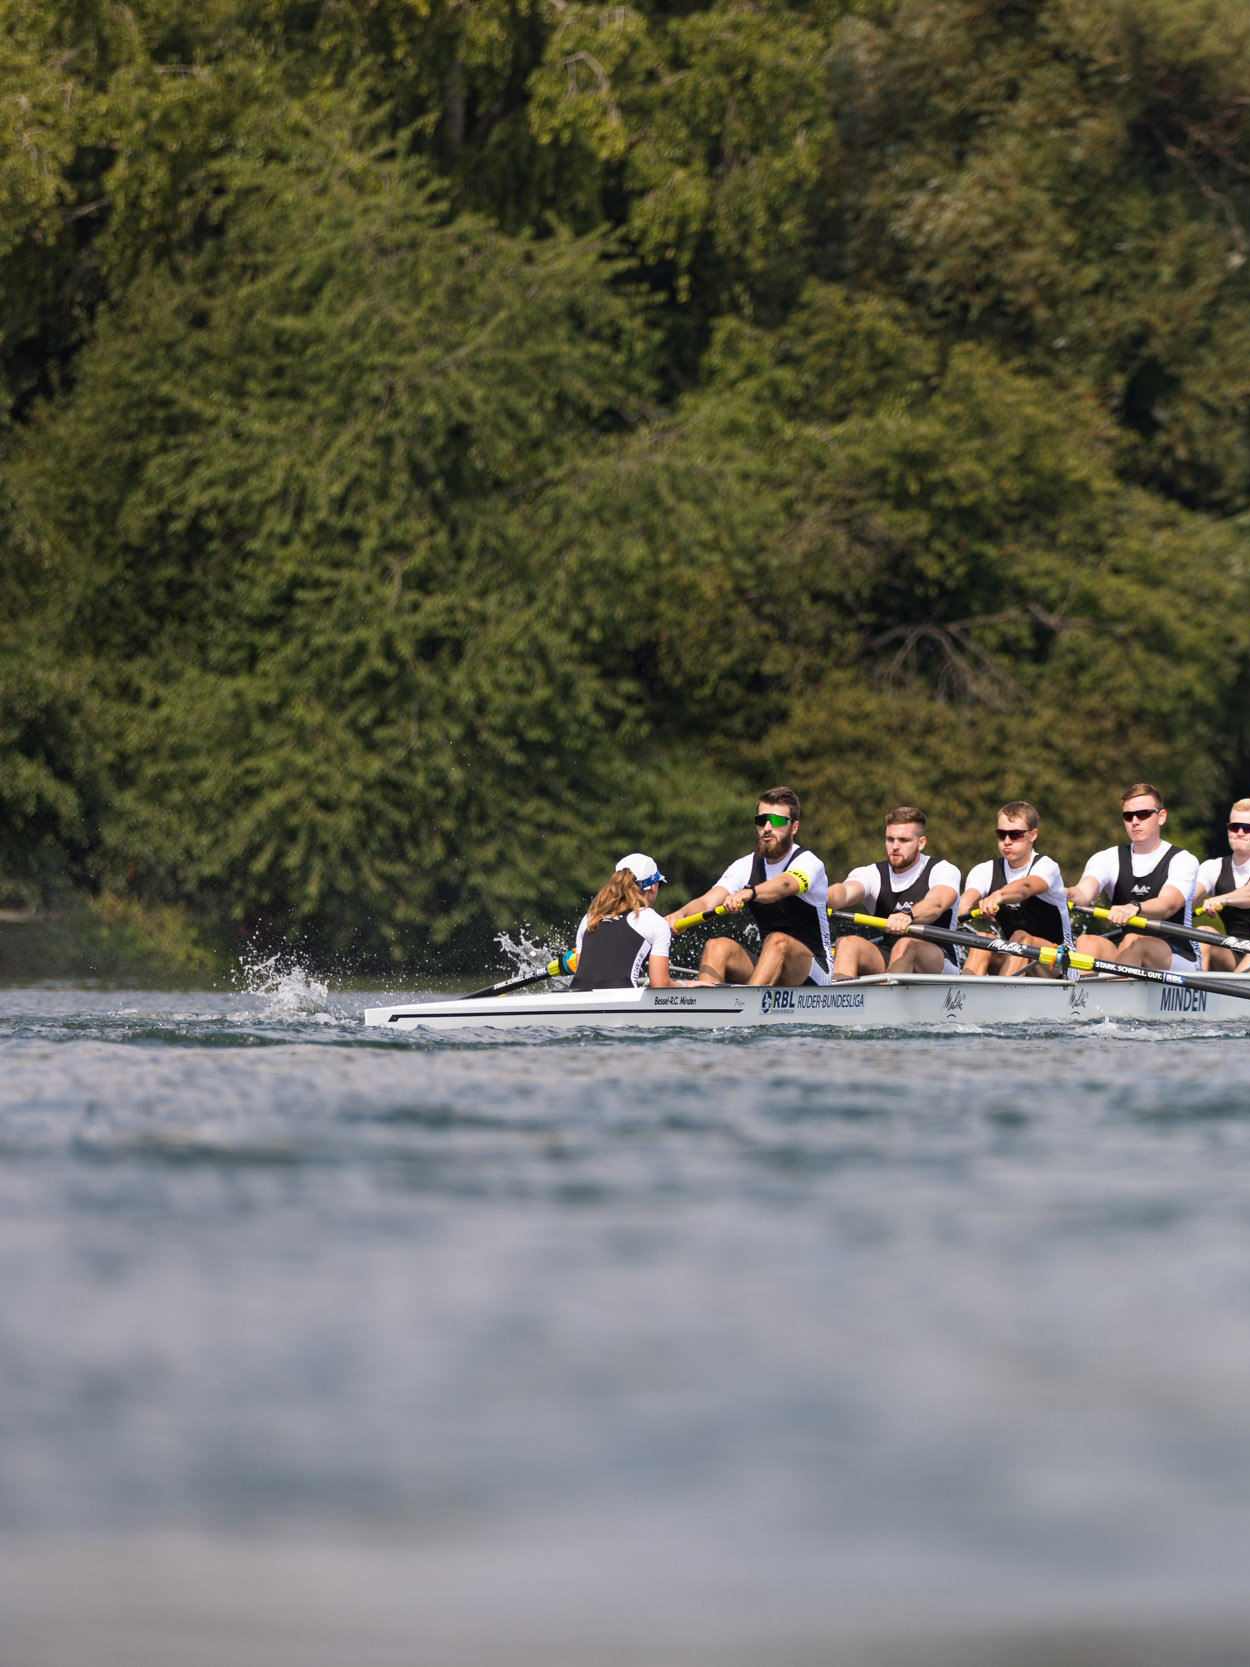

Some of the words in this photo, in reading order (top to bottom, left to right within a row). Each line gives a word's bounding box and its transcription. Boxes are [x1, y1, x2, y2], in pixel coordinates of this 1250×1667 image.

[987, 938, 1024, 955] Melitta
[1095, 961, 1117, 971] STARK.
[1117, 965, 1147, 977] SCHNELL.
[1147, 971, 1162, 980] GUT.
[1166, 974, 1183, 983] RBL
[654, 996, 678, 1006] Bessel-R.C.
[679, 996, 697, 1006] Minden
[773, 991, 796, 1009] RBL
[797, 994, 865, 1009] RUDER-BUNDESLIGA
[1160, 987, 1208, 1012] MINDEN
